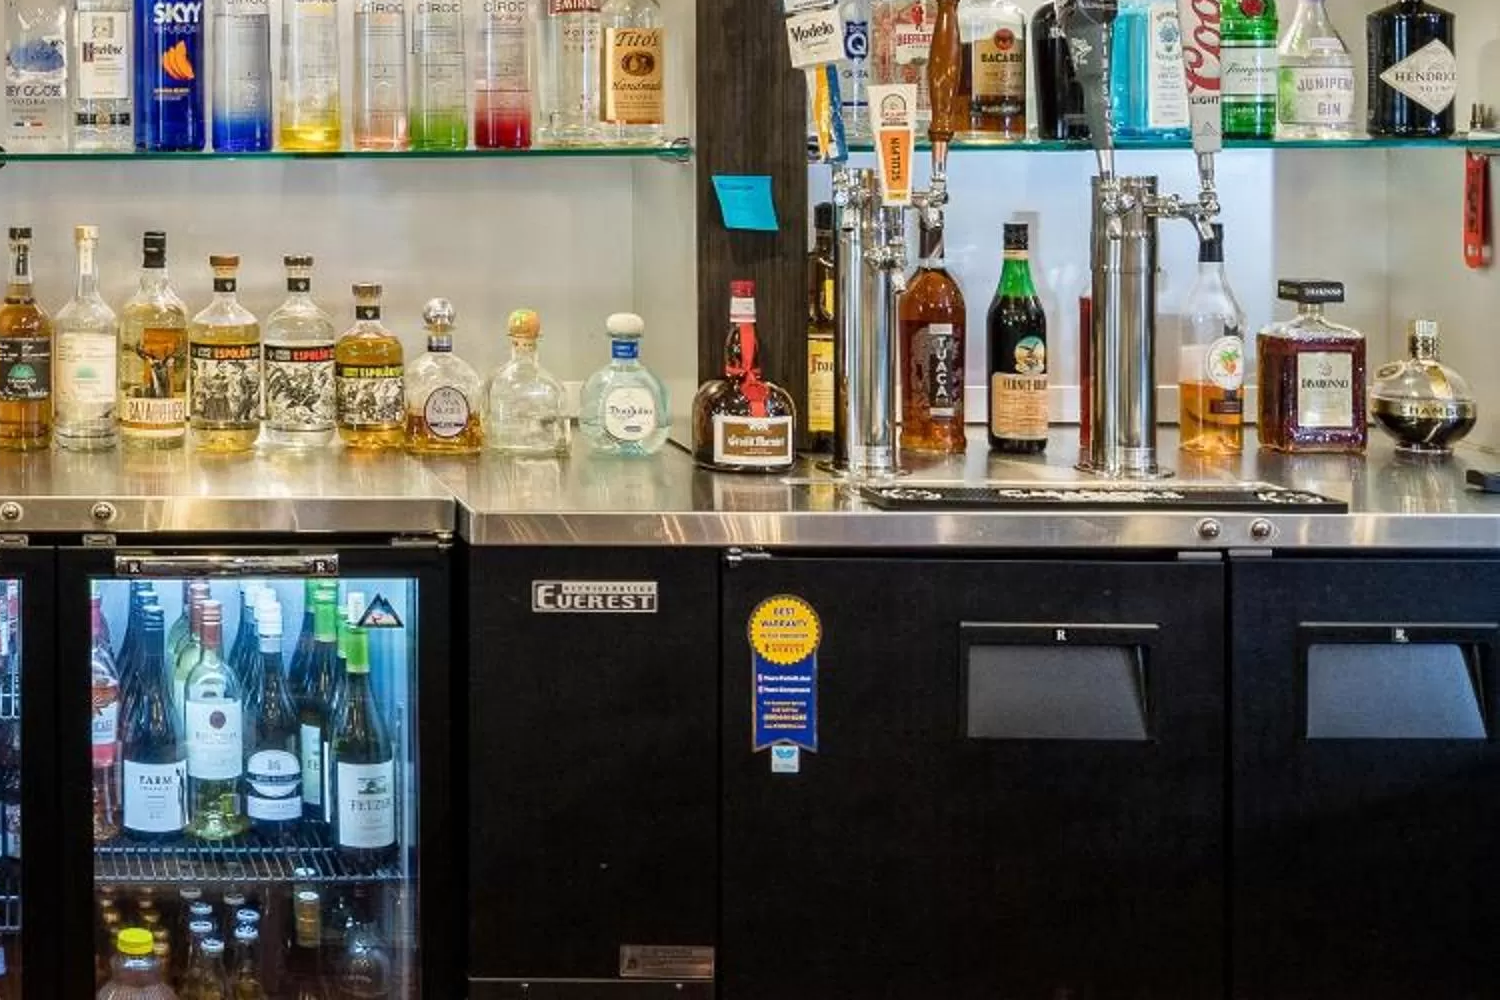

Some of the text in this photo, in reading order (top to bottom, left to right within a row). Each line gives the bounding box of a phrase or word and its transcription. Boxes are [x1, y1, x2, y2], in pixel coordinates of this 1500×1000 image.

[153, 2, 202, 24] SKYY
[614, 31, 660, 47] Tito's
[790, 21, 835, 42] Modelo
[23, 85, 61, 97] GOOSE
[1192, 96, 1220, 105] LIGHT
[1317, 103, 1341, 116] GIN
[934, 337, 950, 397] TUACA
[537, 585, 653, 609] EVEREST
[761, 619, 807, 627] WARRANTY
